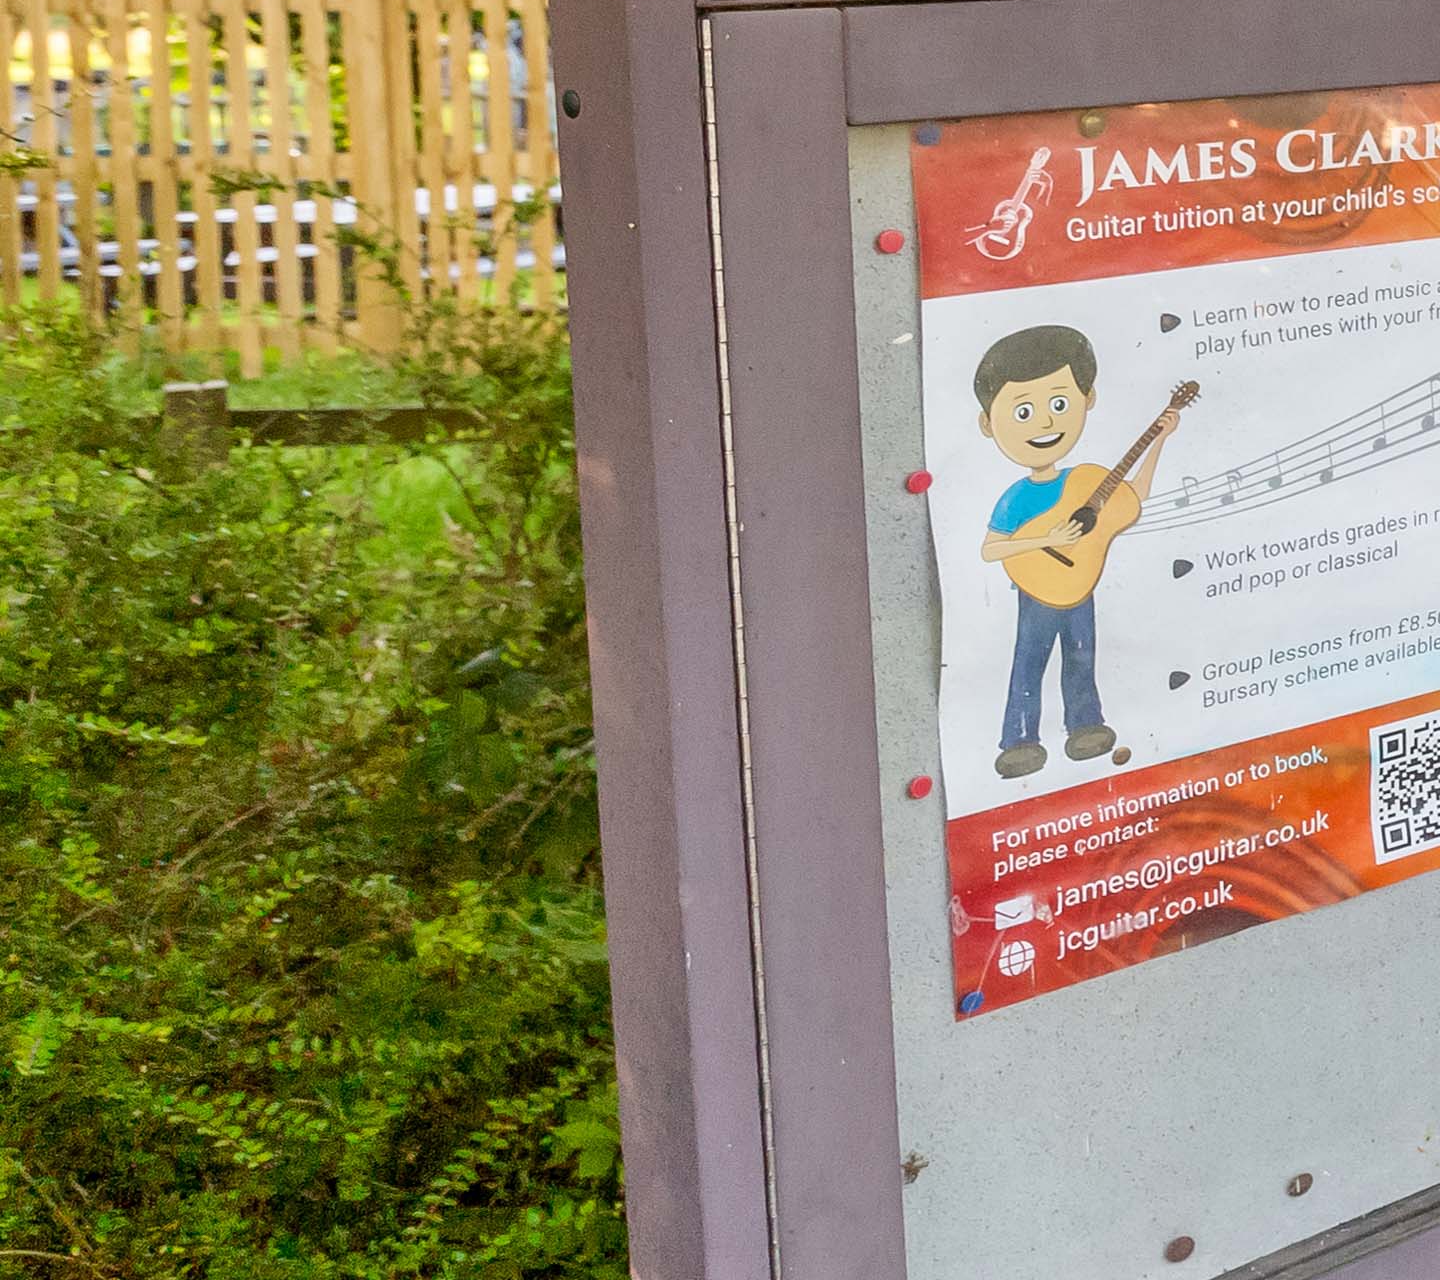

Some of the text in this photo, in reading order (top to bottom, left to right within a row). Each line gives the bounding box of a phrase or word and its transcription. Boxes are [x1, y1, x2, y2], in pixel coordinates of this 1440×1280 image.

[1075, 137, 1257, 207] JAMES
[1066, 212, 1146, 243] Guitar
[1153, 204, 1235, 236] tuition
[1241, 201, 1266, 224] at
[1272, 195, 1326, 225] your
[1332, 182, 1406, 212] child's
[1192, 302, 1247, 328] Learn
[1254, 296, 1294, 322] how
[1301, 293, 1320, 314] to
[1326, 287, 1369, 311] read
[1375, 280, 1431, 305] music
[1194, 331, 1235, 360] play
[1241, 324, 1272, 349] fun
[1278, 319, 1332, 343] tunes
[1339, 312, 1378, 336] with
[1383, 308, 1423, 335] your
[1205, 546, 1257, 572] Work
[1262, 529, 1340, 561] towards
[1345, 518, 1408, 551] grades
[1413, 509, 1429, 529] in
[1205, 541, 1399, 599] and pop or classical
[1202, 655, 1262, 688] Group
[1268, 638, 1342, 670] lessons
[1348, 621, 1392, 651] from
[1203, 680, 1278, 713] Bursary
[1284, 656, 1359, 689] scheme
[992, 746, 1328, 853] For more information or to book,
[994, 814, 1160, 881] please contact:
[1055, 809, 1330, 915] james@jcguitar.co.uk
[1056, 879, 1234, 959] jcguitar.co.uk
